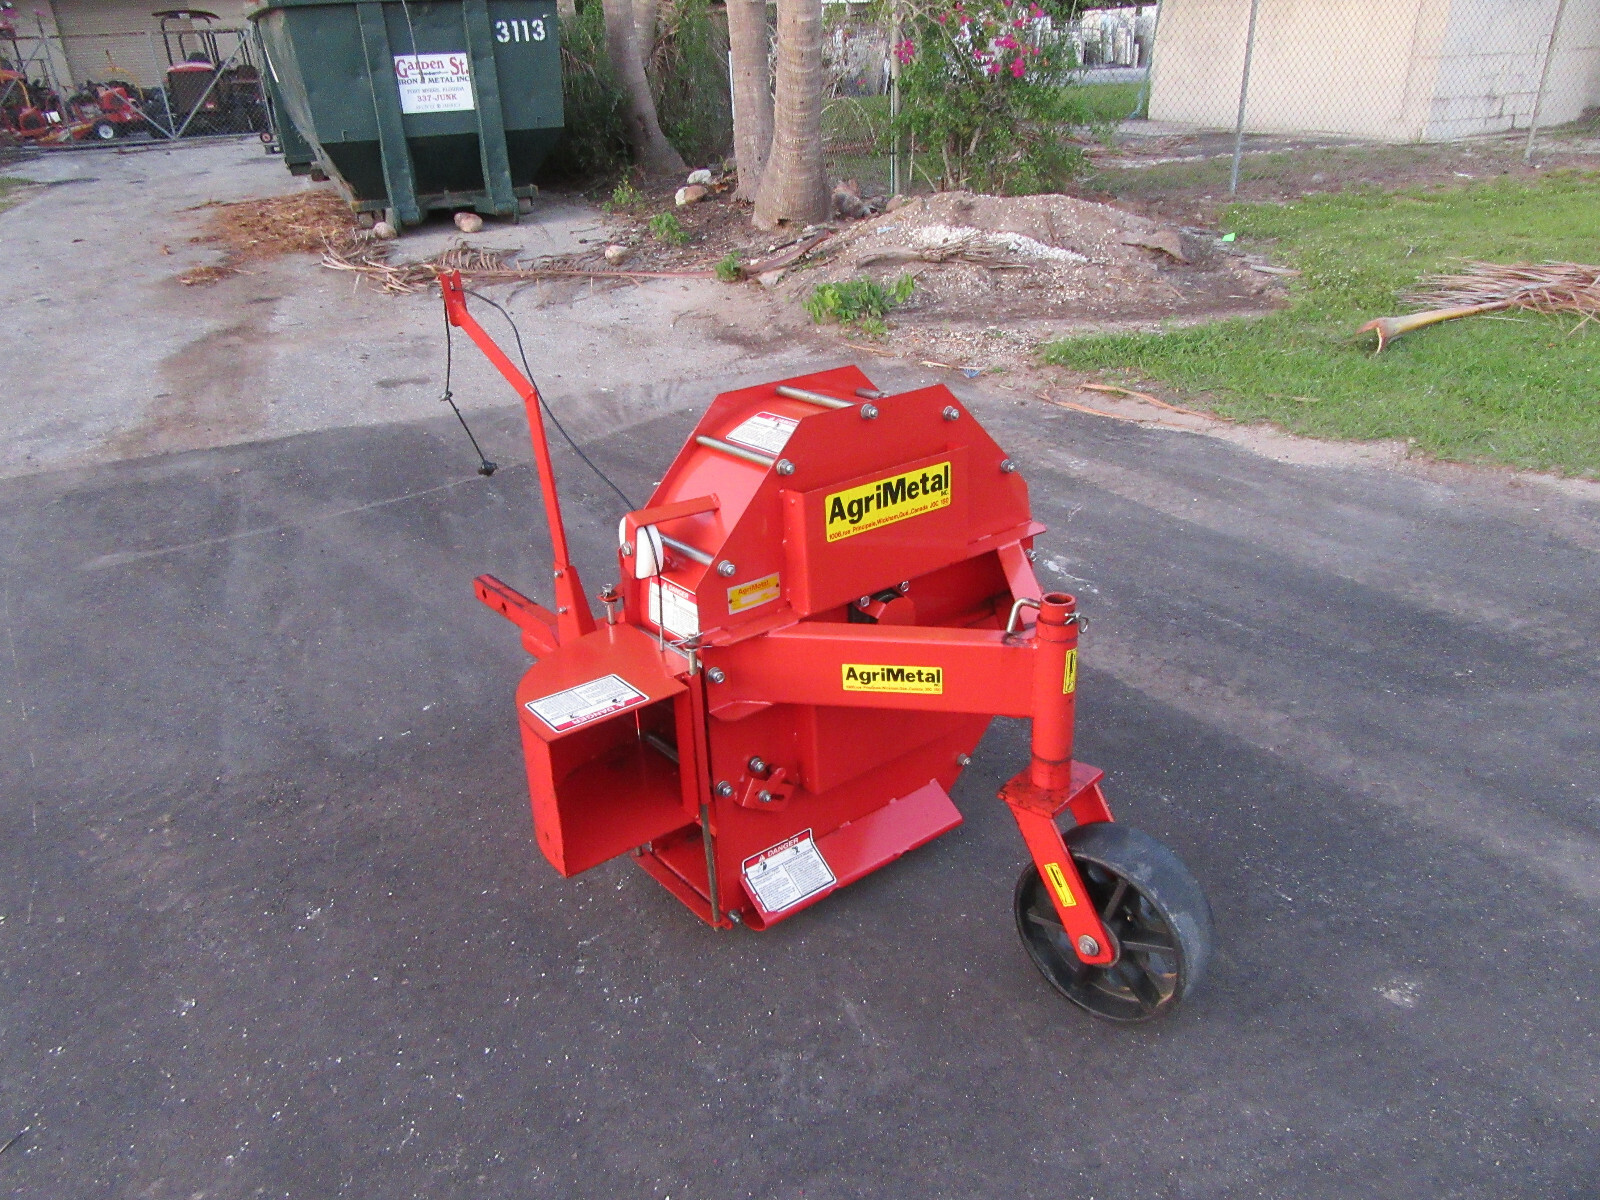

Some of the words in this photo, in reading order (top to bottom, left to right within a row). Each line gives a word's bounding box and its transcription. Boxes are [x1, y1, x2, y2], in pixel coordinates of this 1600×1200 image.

[495, 19, 546, 43] 3113
[395, 59, 444, 78] Garden
[829, 464, 949, 525] AgriMetal
[668, 584, 689, 600] DANGER
[845, 666, 941, 685] AgriMetal
[767, 837, 799, 857] DANGER
